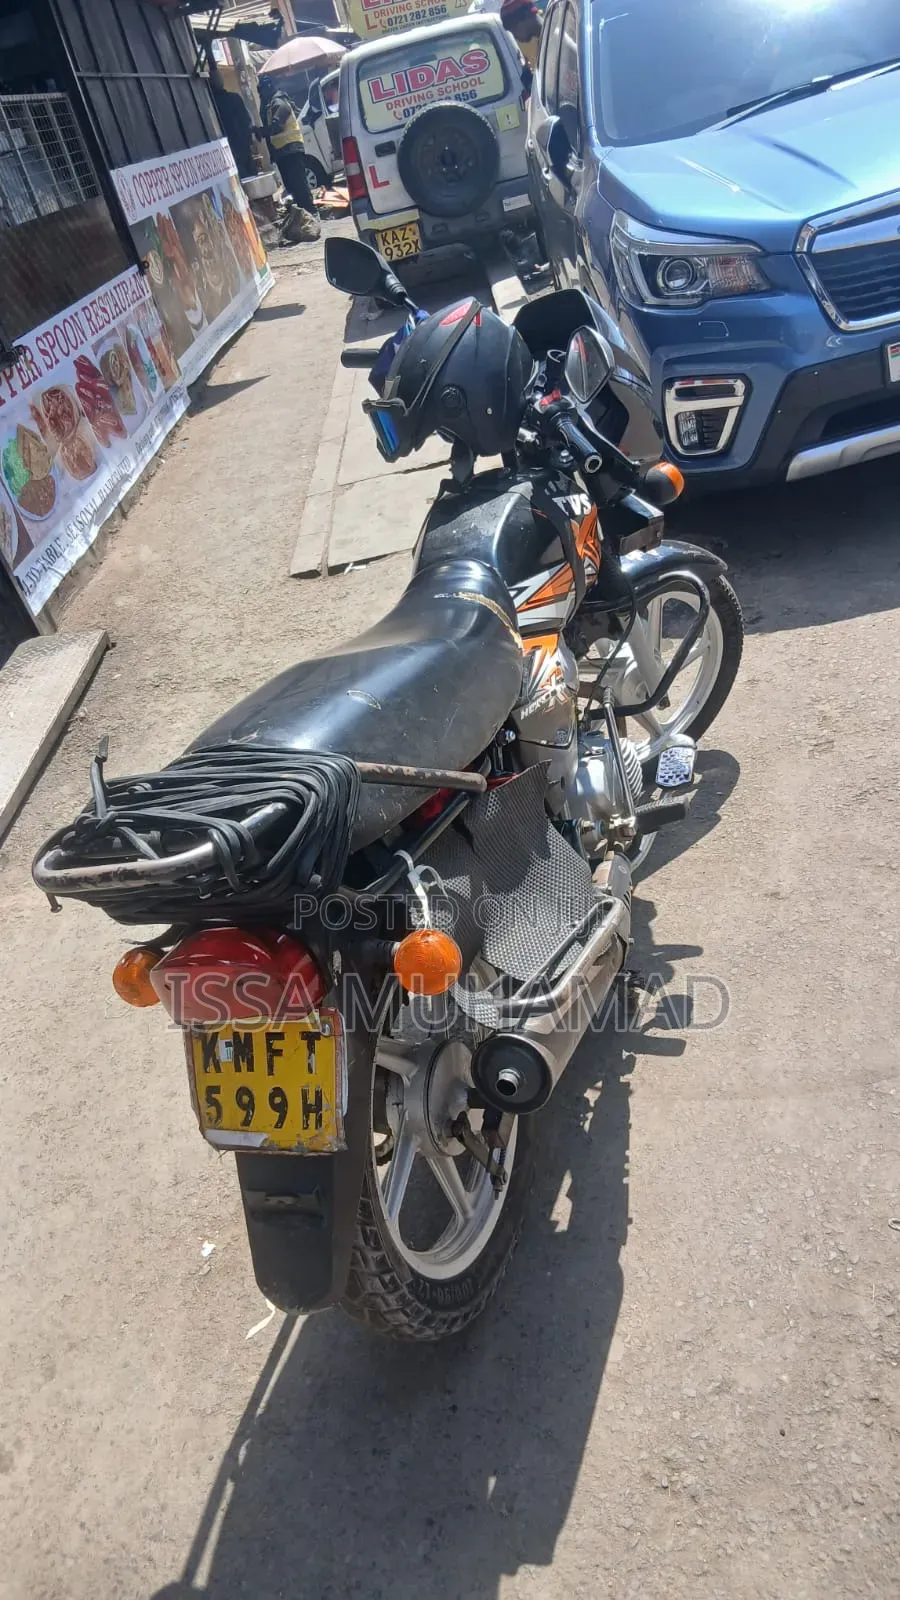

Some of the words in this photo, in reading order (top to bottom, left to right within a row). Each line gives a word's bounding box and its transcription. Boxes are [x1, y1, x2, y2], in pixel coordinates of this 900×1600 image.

[364, 14, 377, 30] L
[373, 2, 413, 19] DRIVING
[387, 14, 408, 27] 0721
[409, 9, 427, 21] 282
[429, 5, 447, 17] 856
[367, 49, 490, 104] LIDAS
[385, 90, 434, 111] DRIVING
[436, 76, 485, 97] SCHOOL
[132, 166, 175, 208] COPPER
[168, 156, 199, 192] SPOON
[368, 165, 390, 189] L
[381, 226, 409, 246] KAZ
[384, 239, 422, 260] 932X
[35, 312, 88, 371] SPOON
[81, 271, 150, 336] RESTAURANT
[552, 493, 591, 516] TVS
[200, 1031, 321, 1076] KMFT
[204, 1085, 323, 1130] 599H
